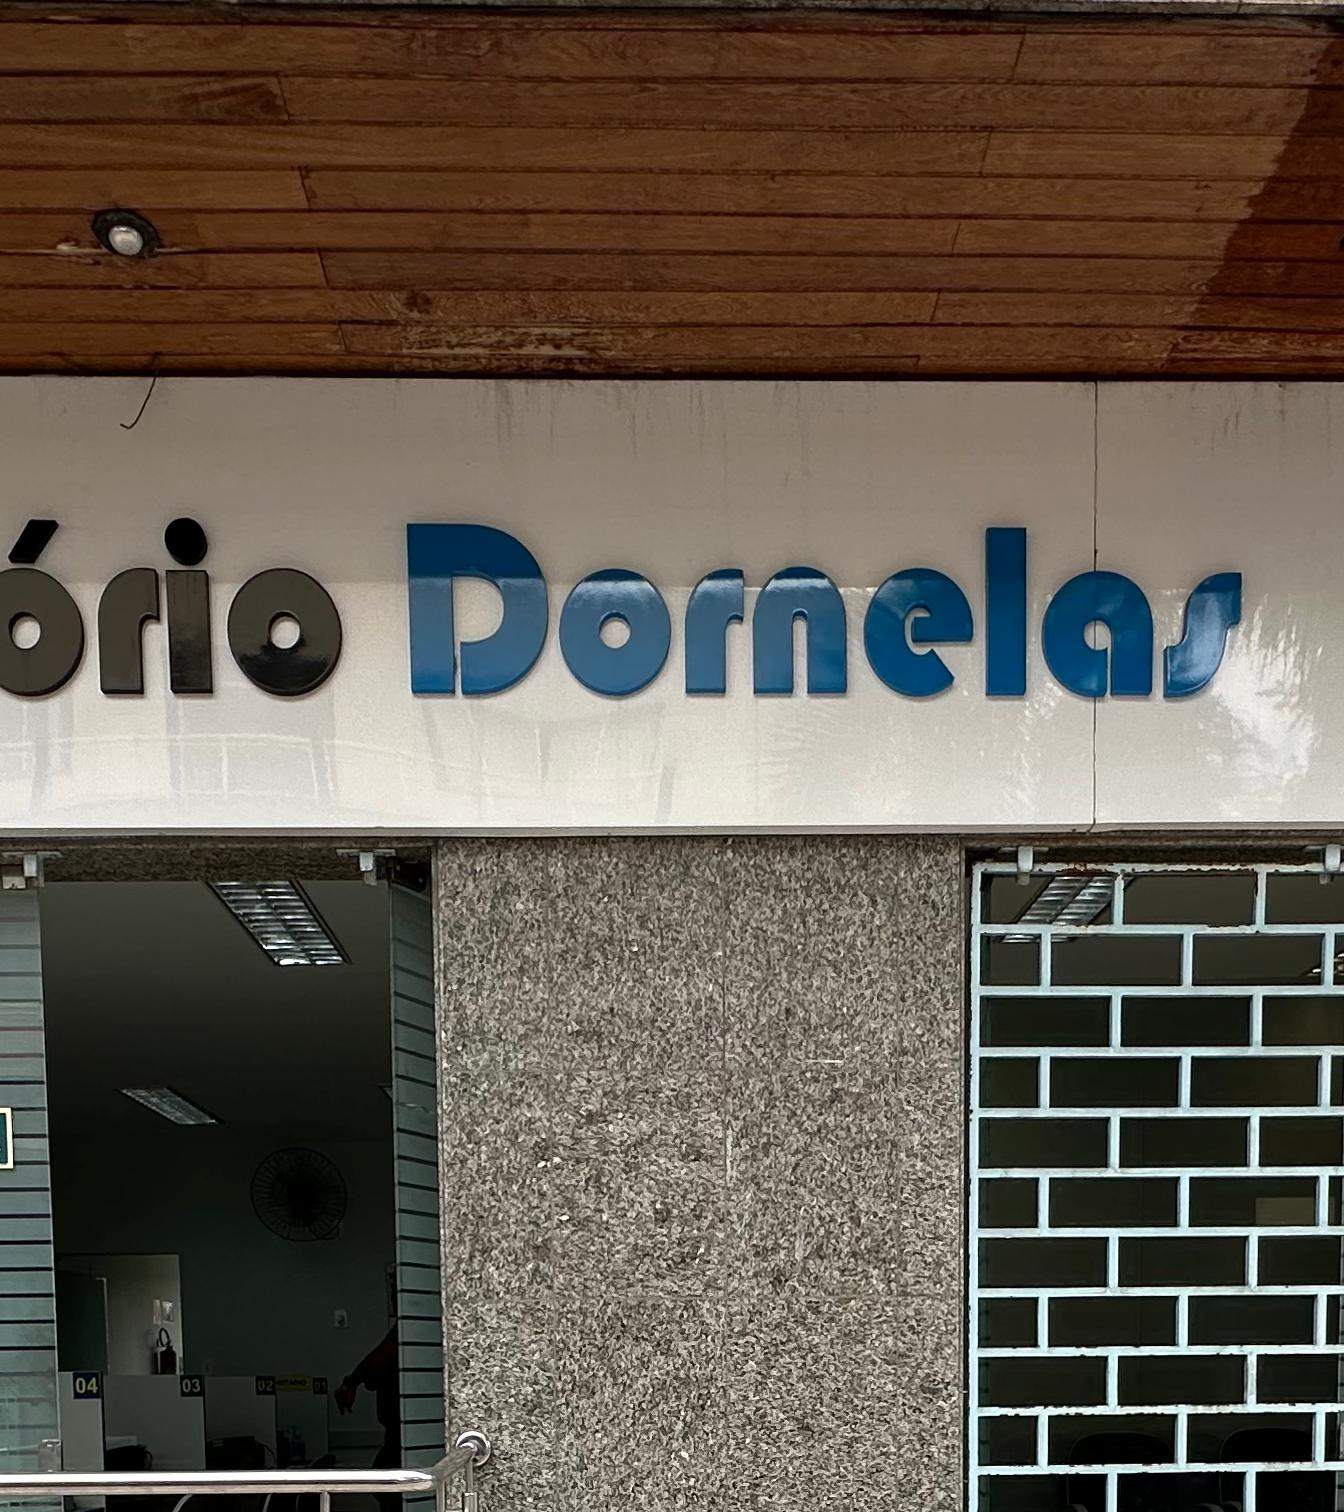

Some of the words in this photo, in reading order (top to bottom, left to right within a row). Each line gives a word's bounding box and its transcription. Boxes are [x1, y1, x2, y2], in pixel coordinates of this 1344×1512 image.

[406, 522, 1243, 698] Dornelas
[76, 1377, 98, 1393] 04
[182, 1379, 201, 1392] 03
[257, 1380, 273, 1391] 02
